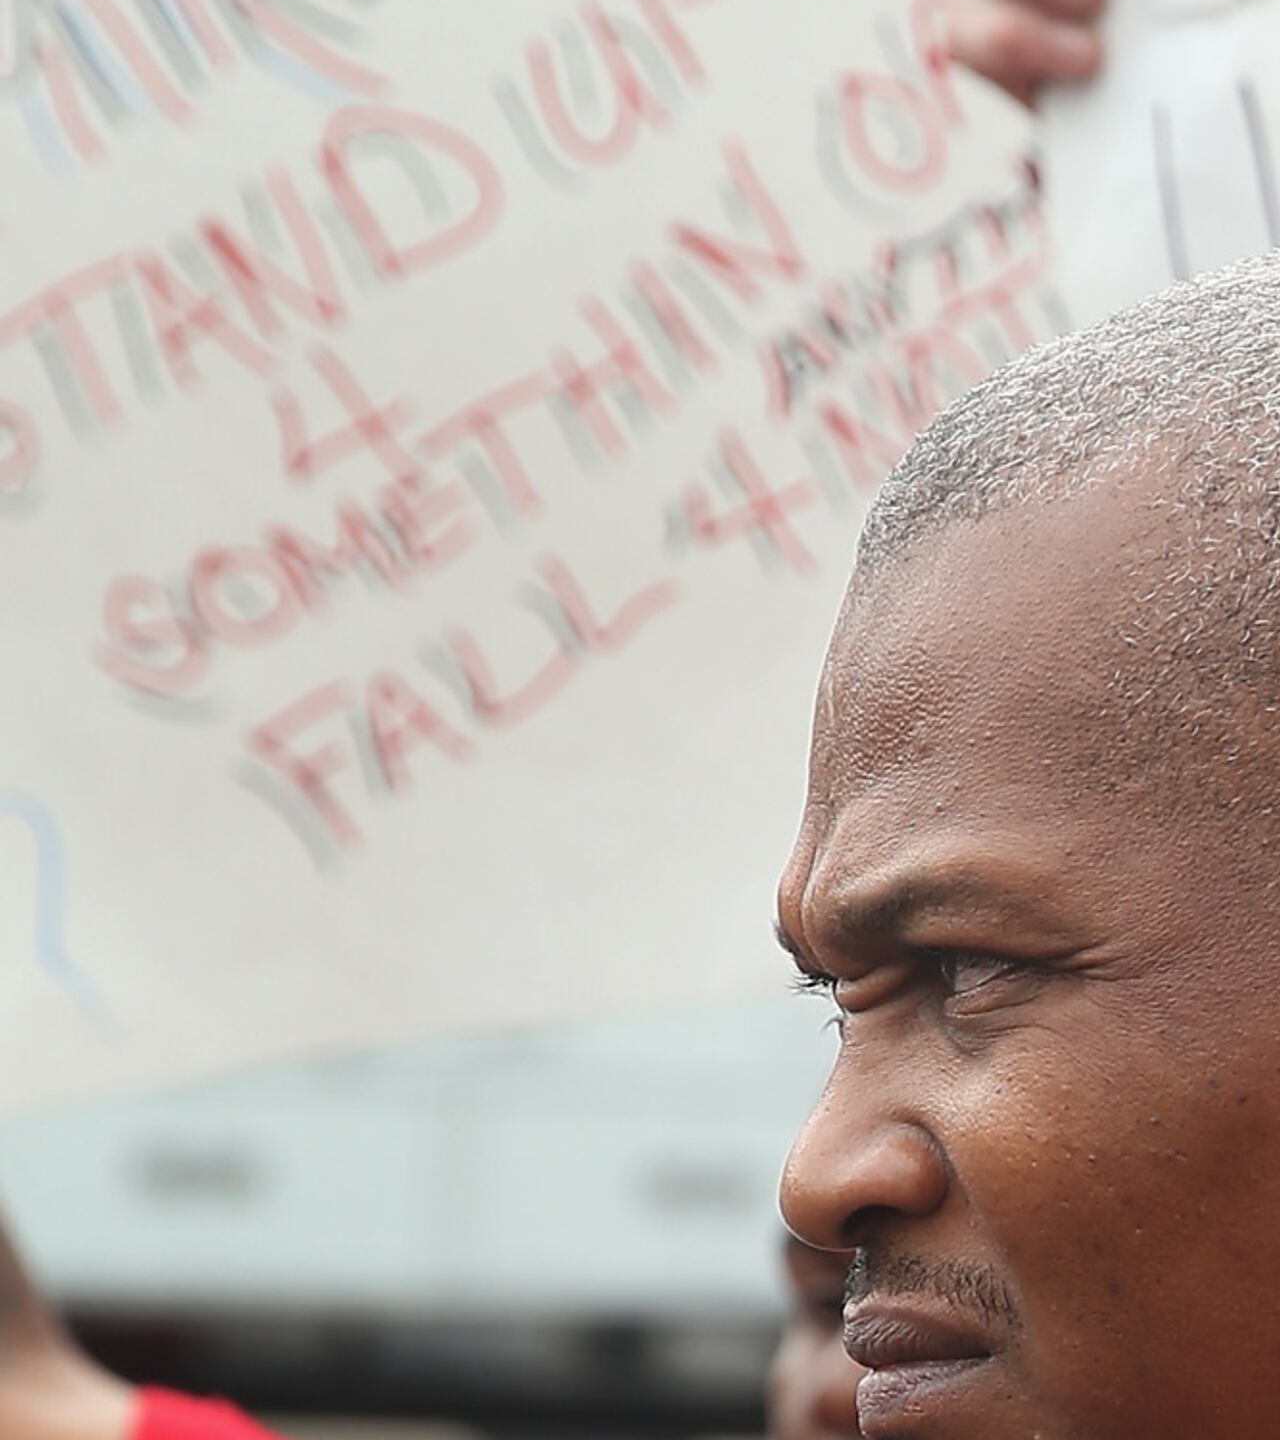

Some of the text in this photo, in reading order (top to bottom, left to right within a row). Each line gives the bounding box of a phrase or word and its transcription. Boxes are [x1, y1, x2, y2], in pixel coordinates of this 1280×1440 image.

[92, 135, 812, 718] SOMETHIN
[268, 342, 424, 488] 4
[238, 545, 684, 860] FALL
